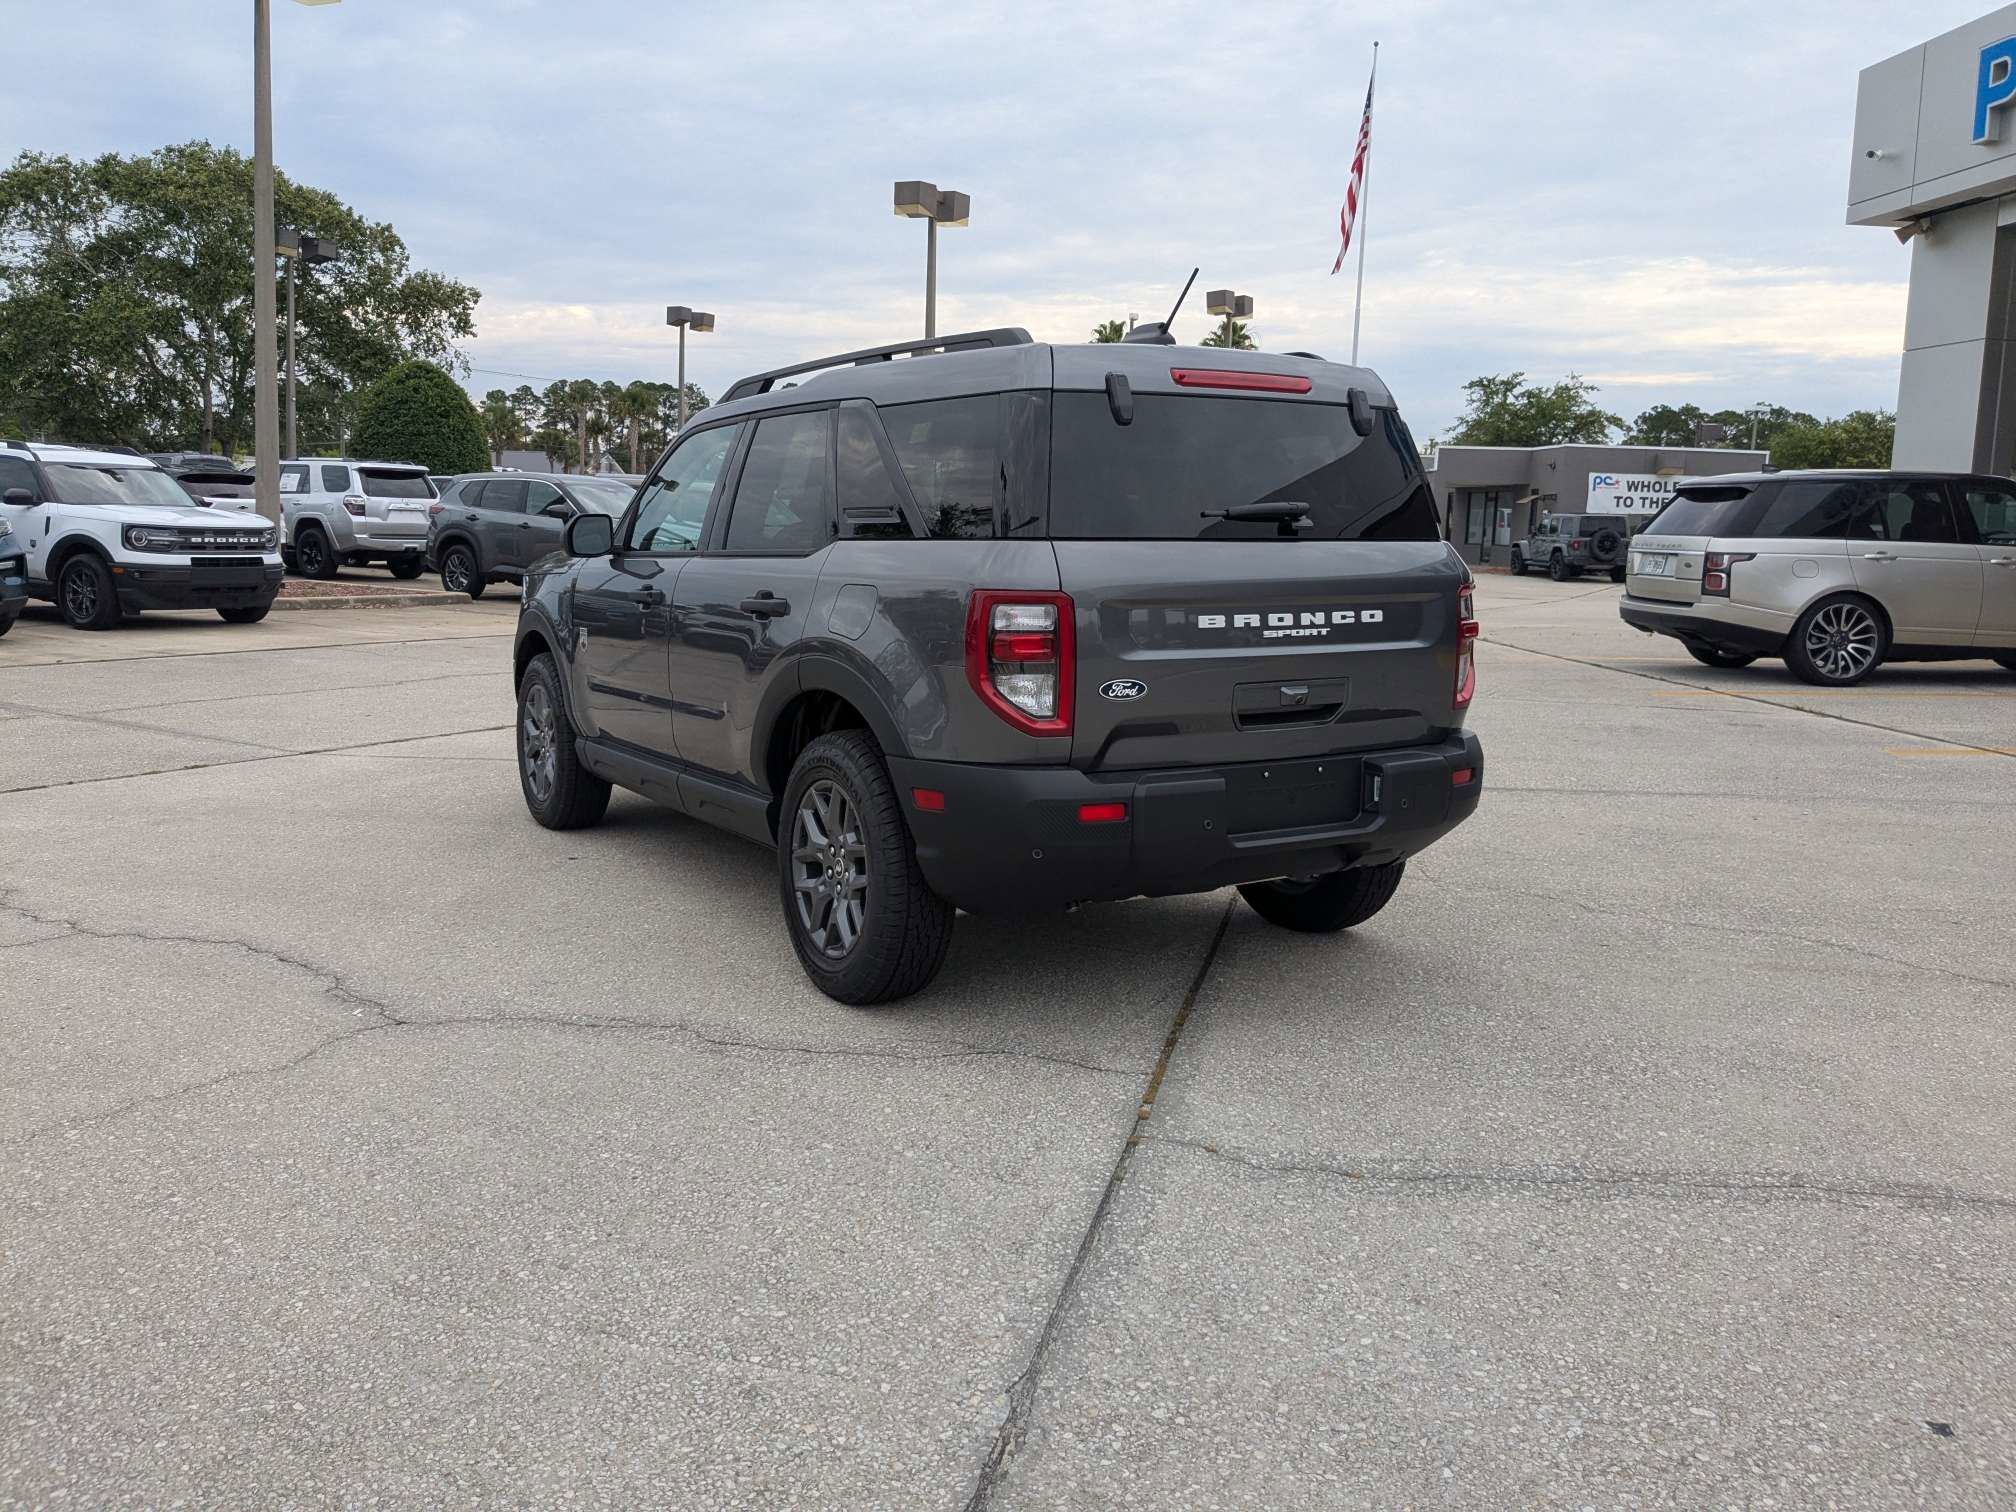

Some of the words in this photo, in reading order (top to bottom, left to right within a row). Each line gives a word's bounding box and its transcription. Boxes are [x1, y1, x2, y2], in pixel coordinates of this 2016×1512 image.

[1613, 495, 1634, 508] TO
[1197, 610, 1383, 629] BRONCO
[1263, 628, 1331, 638] SPORT
